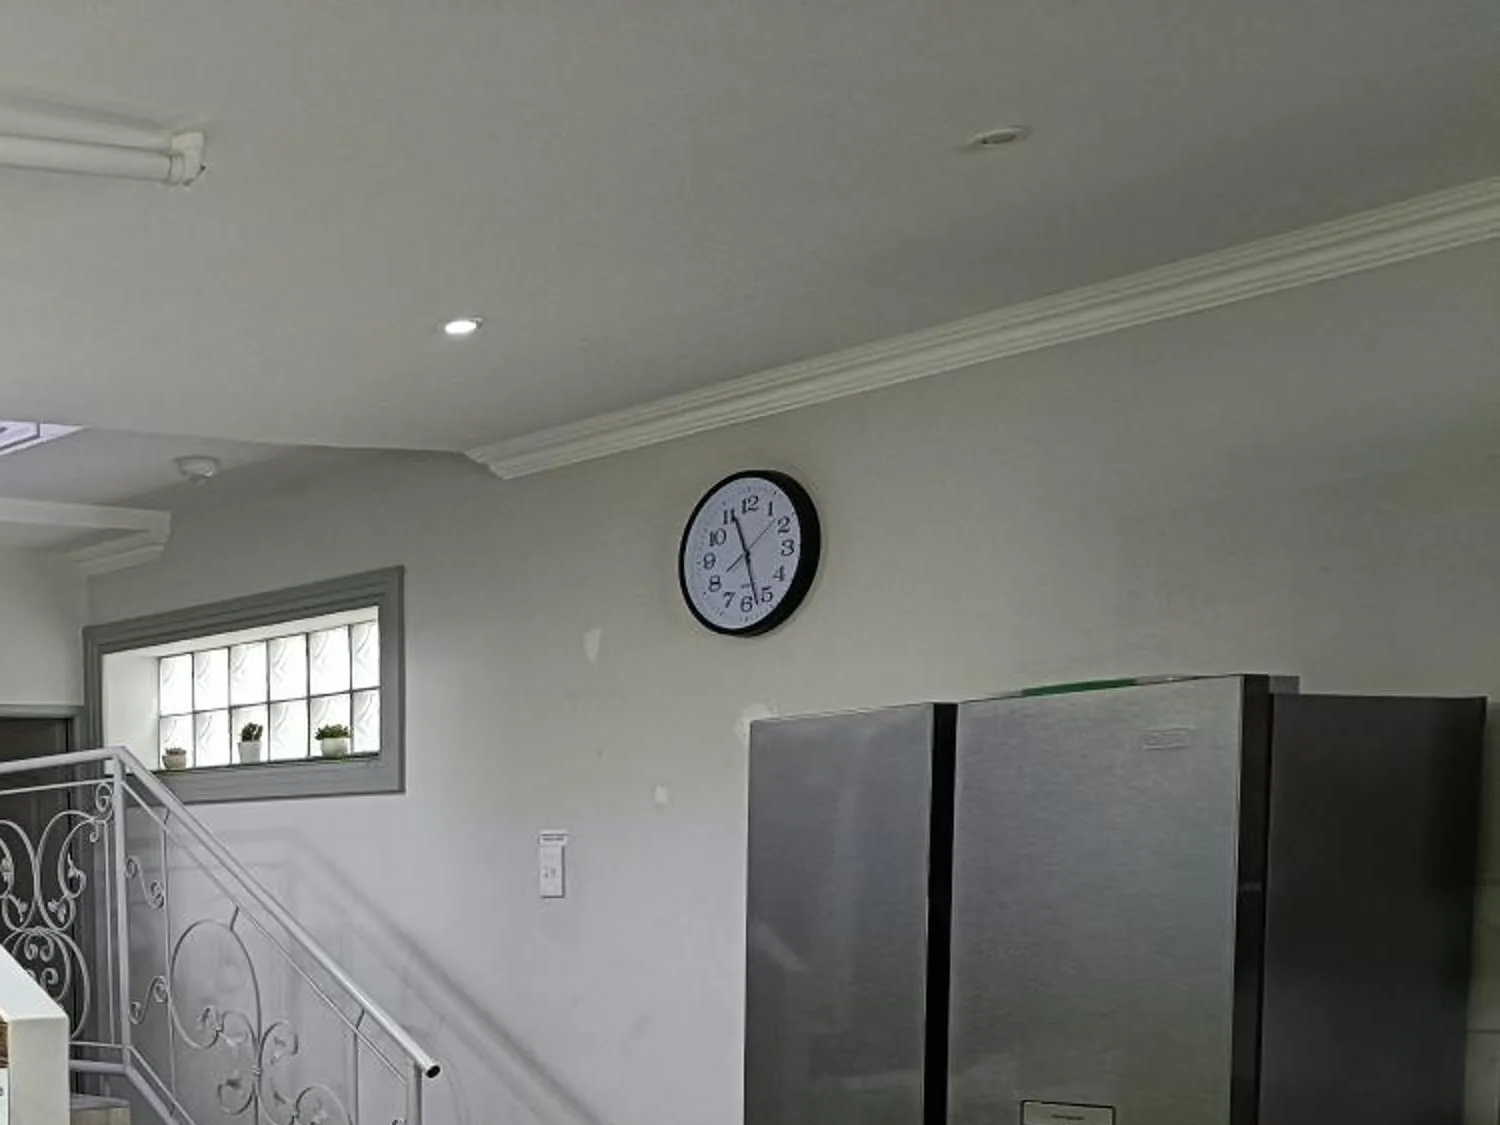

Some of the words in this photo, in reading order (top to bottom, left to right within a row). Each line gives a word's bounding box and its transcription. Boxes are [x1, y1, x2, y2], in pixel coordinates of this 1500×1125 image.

[741, 495, 759, 514] 12
[767, 501, 773, 517] 1
[723, 508, 736, 525] 11
[777, 516, 791, 534] 2
[709, 528, 727, 547] 10
[781, 539, 795, 557] 3
[703, 552, 716, 570] 9
[772, 565, 786, 582] 4
[708, 575, 721, 592] 8
[723, 591, 736, 608] 7
[761, 585, 774, 603] 5
[740, 595, 753, 613] 6
